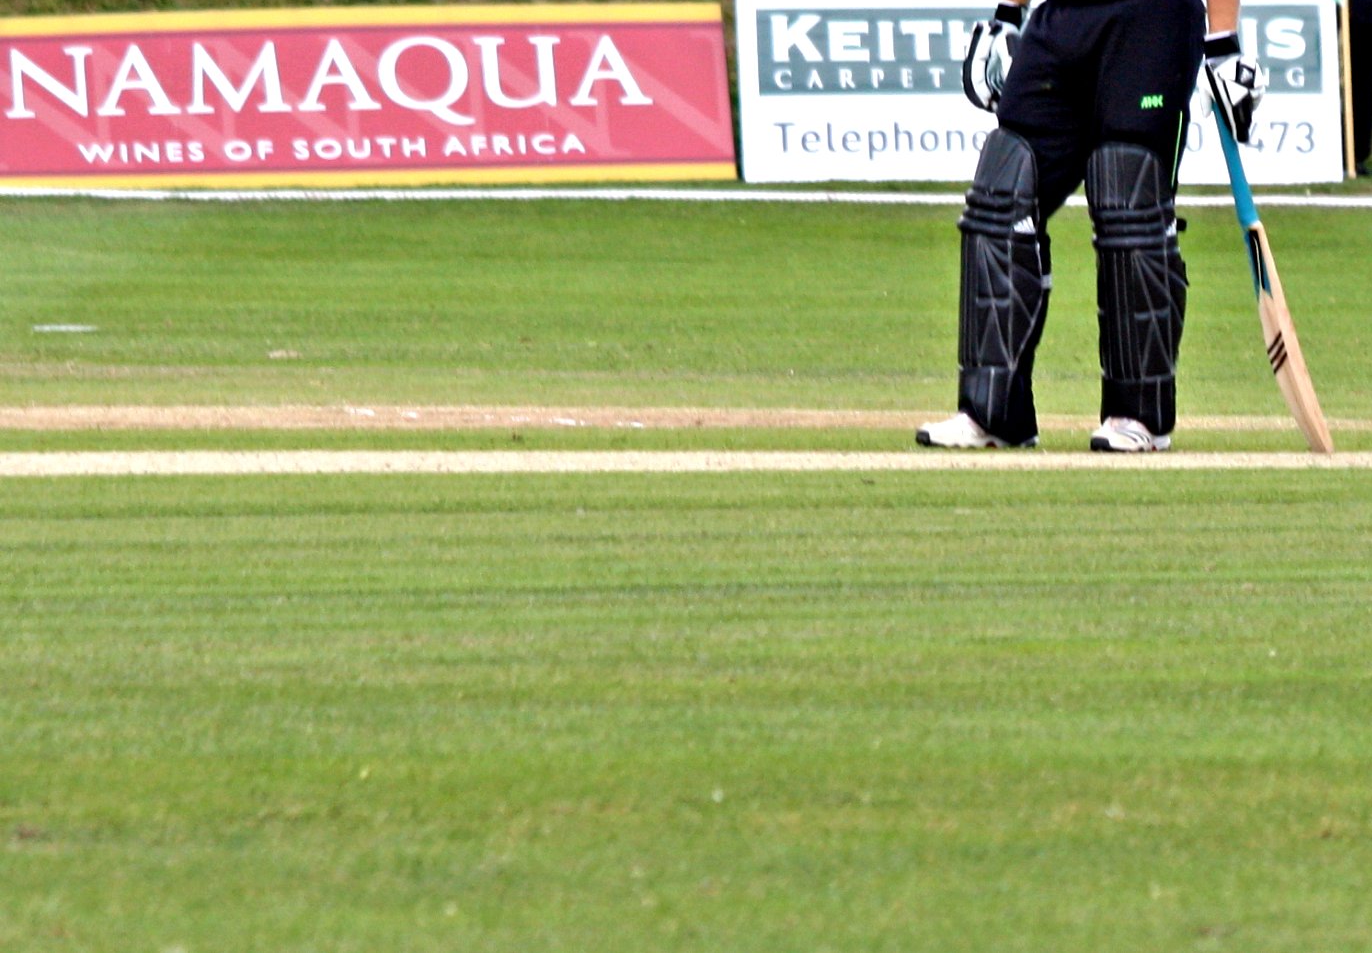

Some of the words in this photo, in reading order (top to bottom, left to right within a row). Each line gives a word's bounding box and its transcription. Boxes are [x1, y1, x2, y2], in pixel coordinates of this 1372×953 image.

[770, 14, 989, 63] KEITH
[5, 33, 654, 126] NAMAQUA
[78, 140, 205, 164] WINES
[223, 139, 274, 162] OF
[291, 134, 427, 161] SOUTH
[443, 129, 587, 158] AFRICA
[773, 121, 988, 161] Telephone
